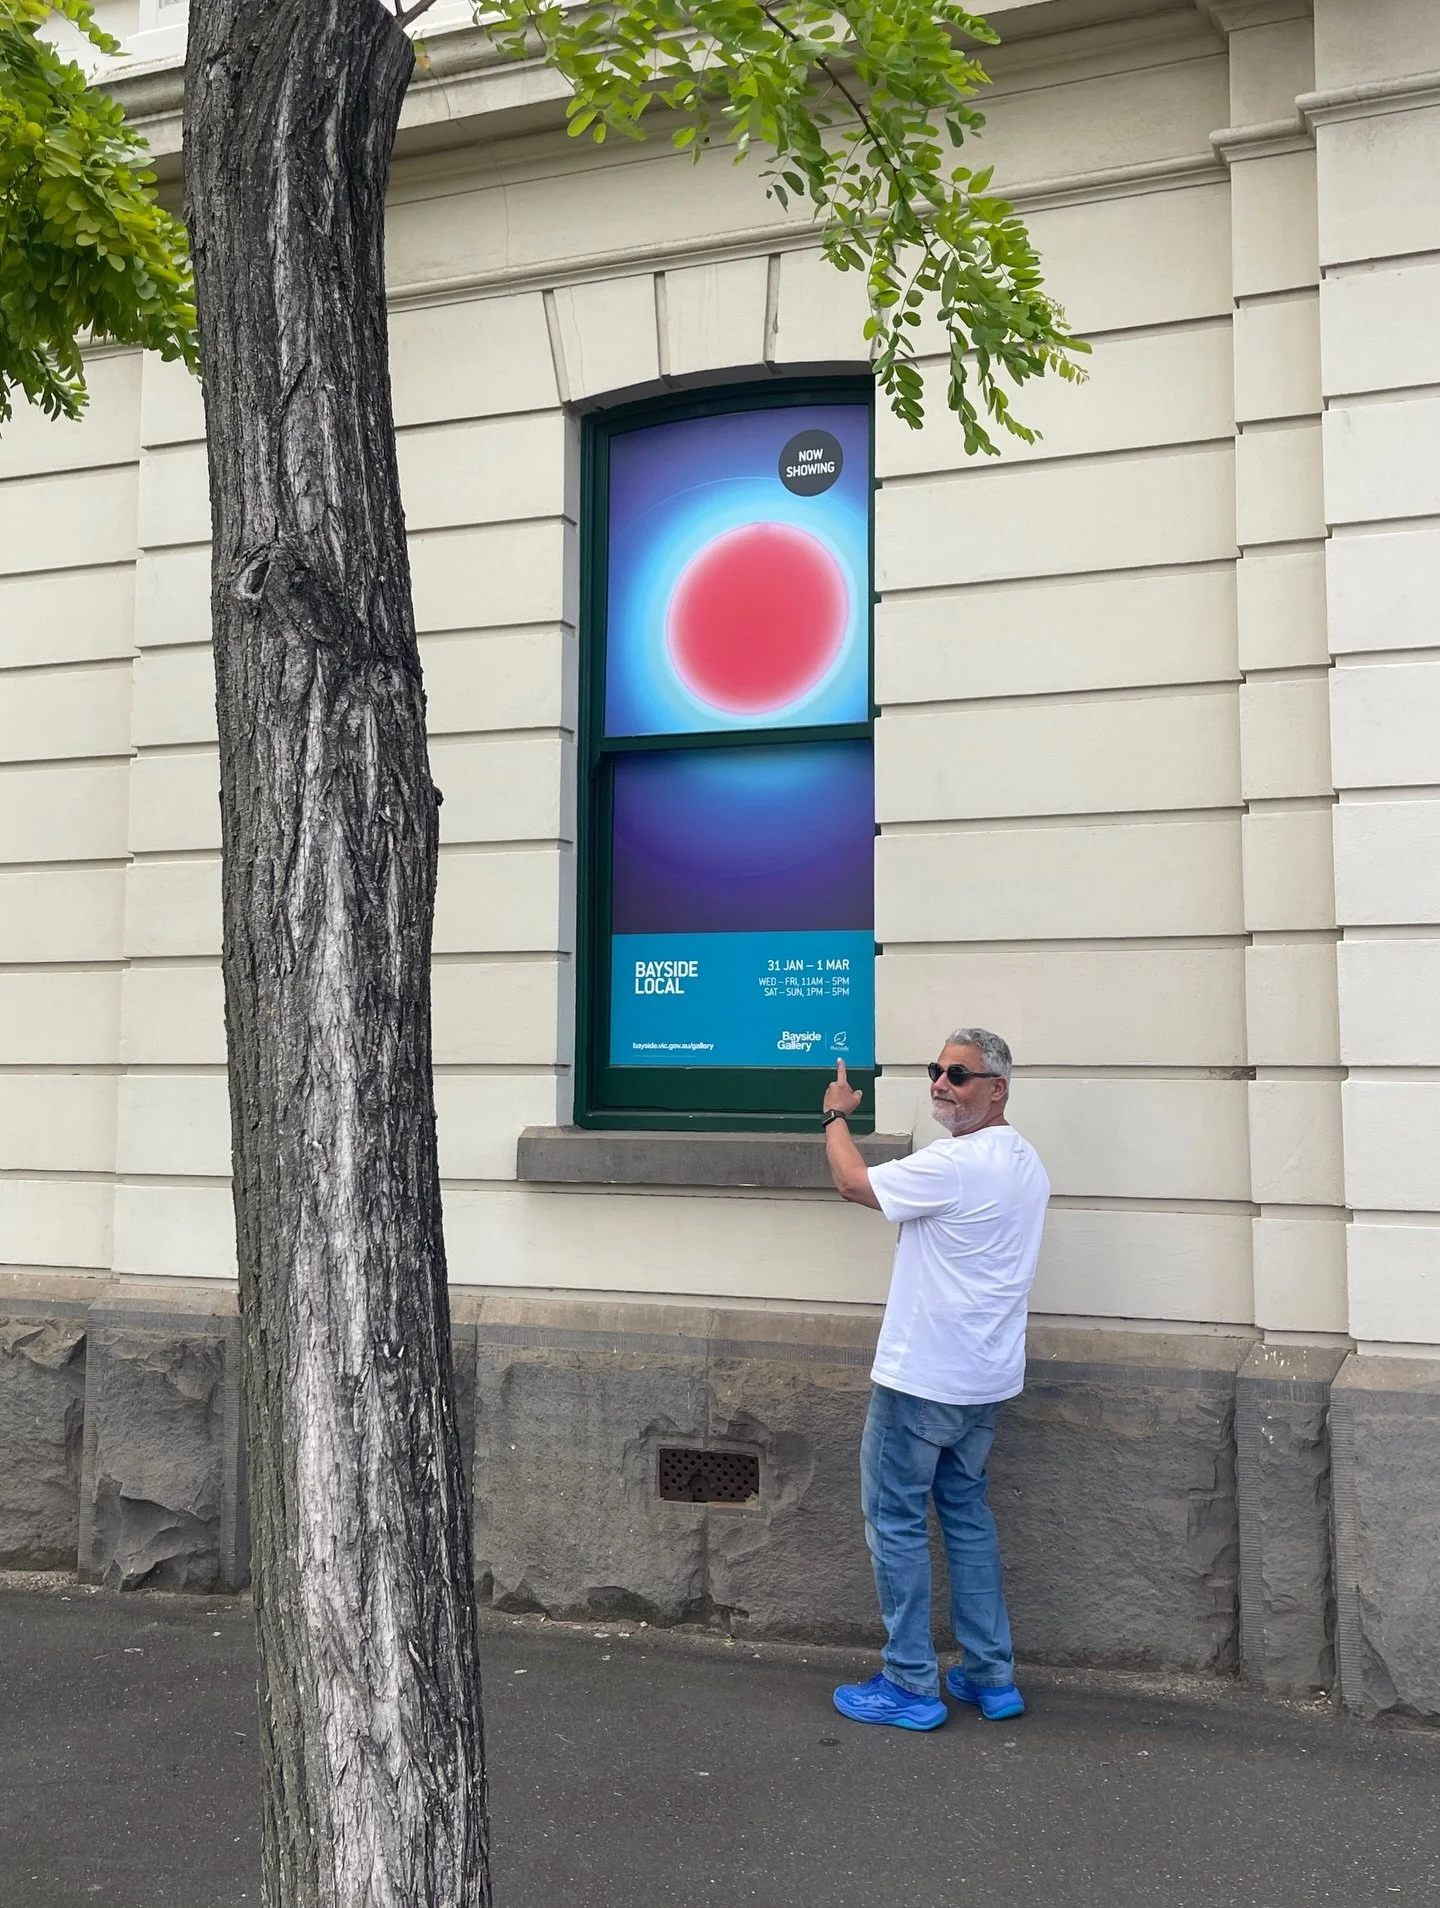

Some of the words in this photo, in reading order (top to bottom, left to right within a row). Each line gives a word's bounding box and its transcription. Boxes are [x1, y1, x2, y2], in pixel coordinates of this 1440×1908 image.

[798, 448, 823, 462] NOW
[786, 461, 835, 477] SHOWING
[635, 960, 699, 978] BAYSIDE
[767, 959, 781, 971] 31
[782, 959, 804, 971] JAN
[816, 959, 824, 971] 1
[825, 959, 850, 971] MAR
[634, 977, 685, 995] LOCAL
[758, 976, 777, 986] WED
[785, 976, 800, 987] FRI,
[801, 976, 824, 986] 11AM
[831, 976, 850, 986] 5PM
[763, 987, 778, 997] SAT
[786, 987, 805, 998] SUN,
[806, 987, 824, 997] 1PM
[831, 987, 850, 997] 5PM
[782, 1030, 822, 1043] Bayside
[632, 1041, 714, 1051] bayside.vic.gov.au/gallery
[777, 1041, 812, 1053] Gallery
